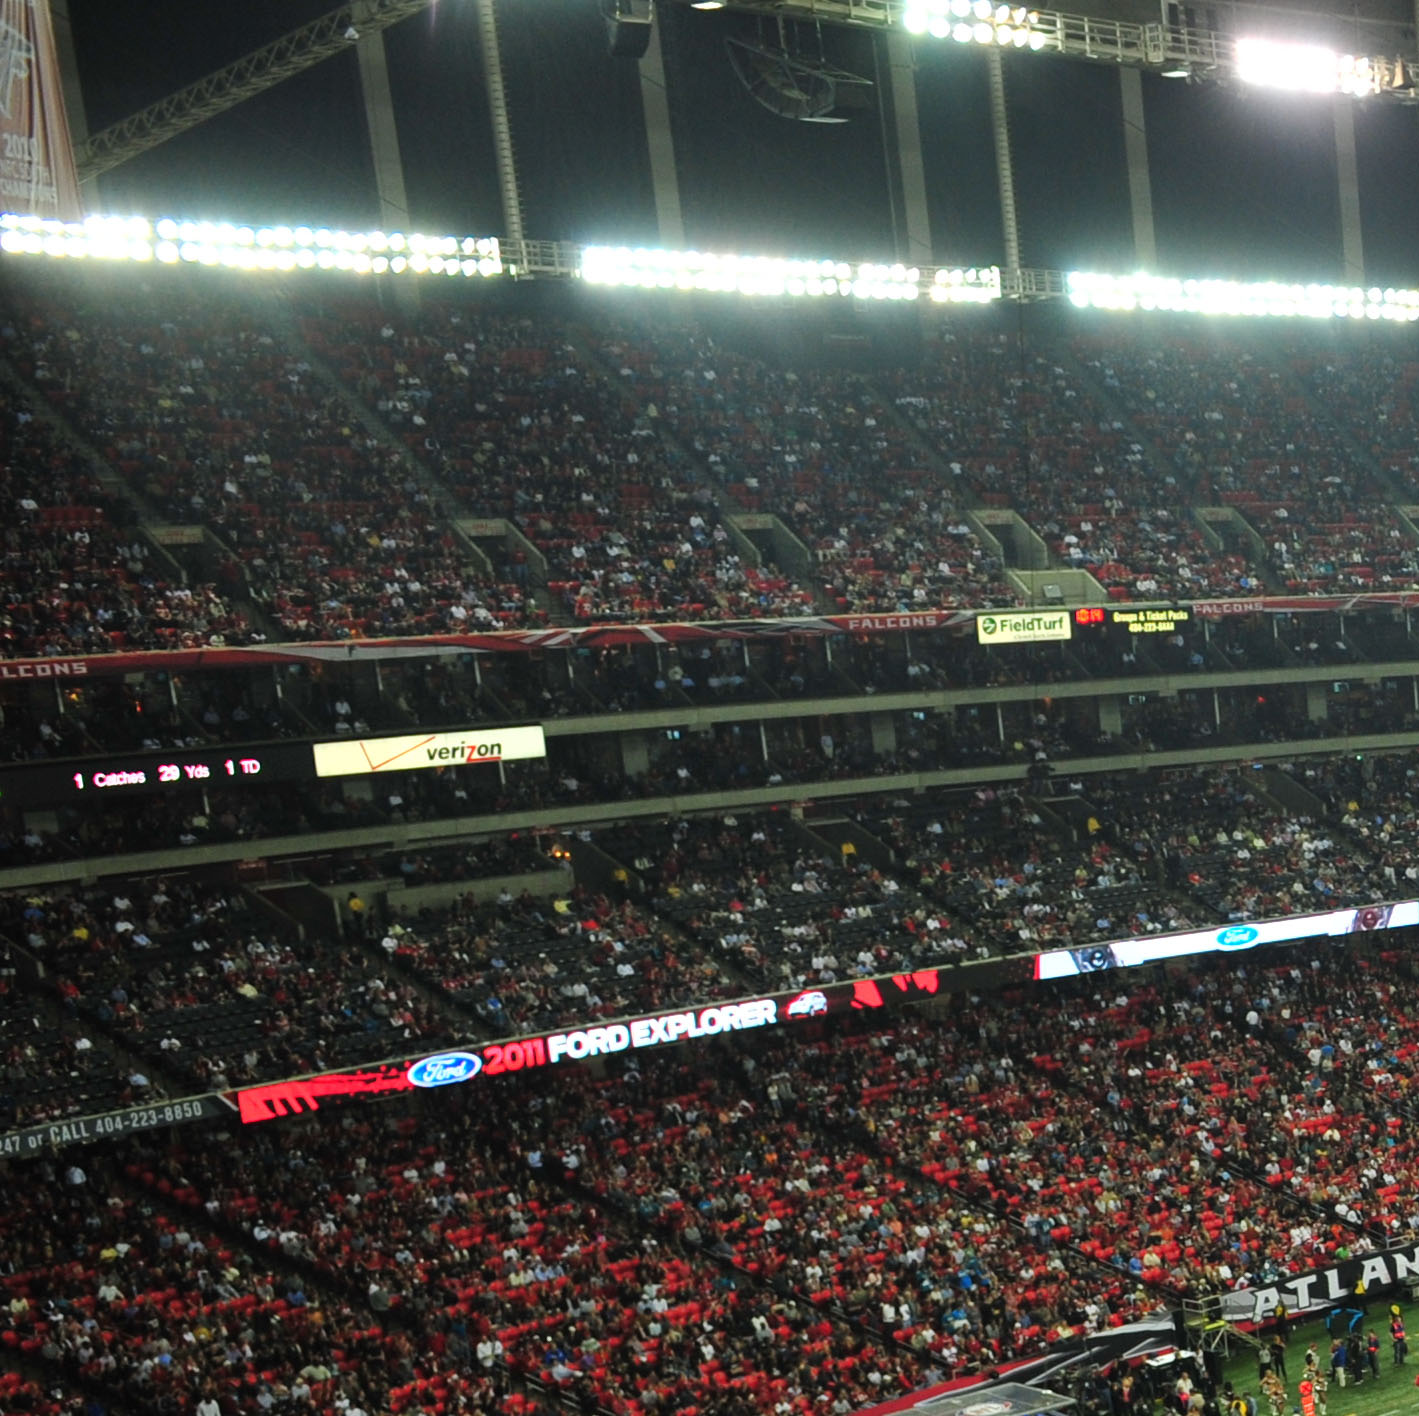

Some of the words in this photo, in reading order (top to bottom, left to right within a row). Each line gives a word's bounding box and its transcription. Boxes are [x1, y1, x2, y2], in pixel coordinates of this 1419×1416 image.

[1193, 602, 1263, 614] FALCONS
[849, 615, 937, 629] FALCONS
[1000, 617, 1064, 633] FieldTurf
[426, 741, 503, 763] verizon
[73, 773, 84, 790] 1
[94, 770, 145, 788] Catches
[158, 765, 181, 782] 29
[185, 763, 210, 780] Yds
[225, 760, 235, 776] 1
[241, 759, 260, 774] TD
[484, 1040, 545, 1077] 2011
[547, 1024, 630, 1063] FORD
[630, 999, 777, 1048] EXPLORER
[0, 1136, 20, 1153] 47
[28, 1134, 43, 1148] or
[50, 1122, 90, 1143] CALL
[96, 1101, 202, 1133] 404-223-8850
